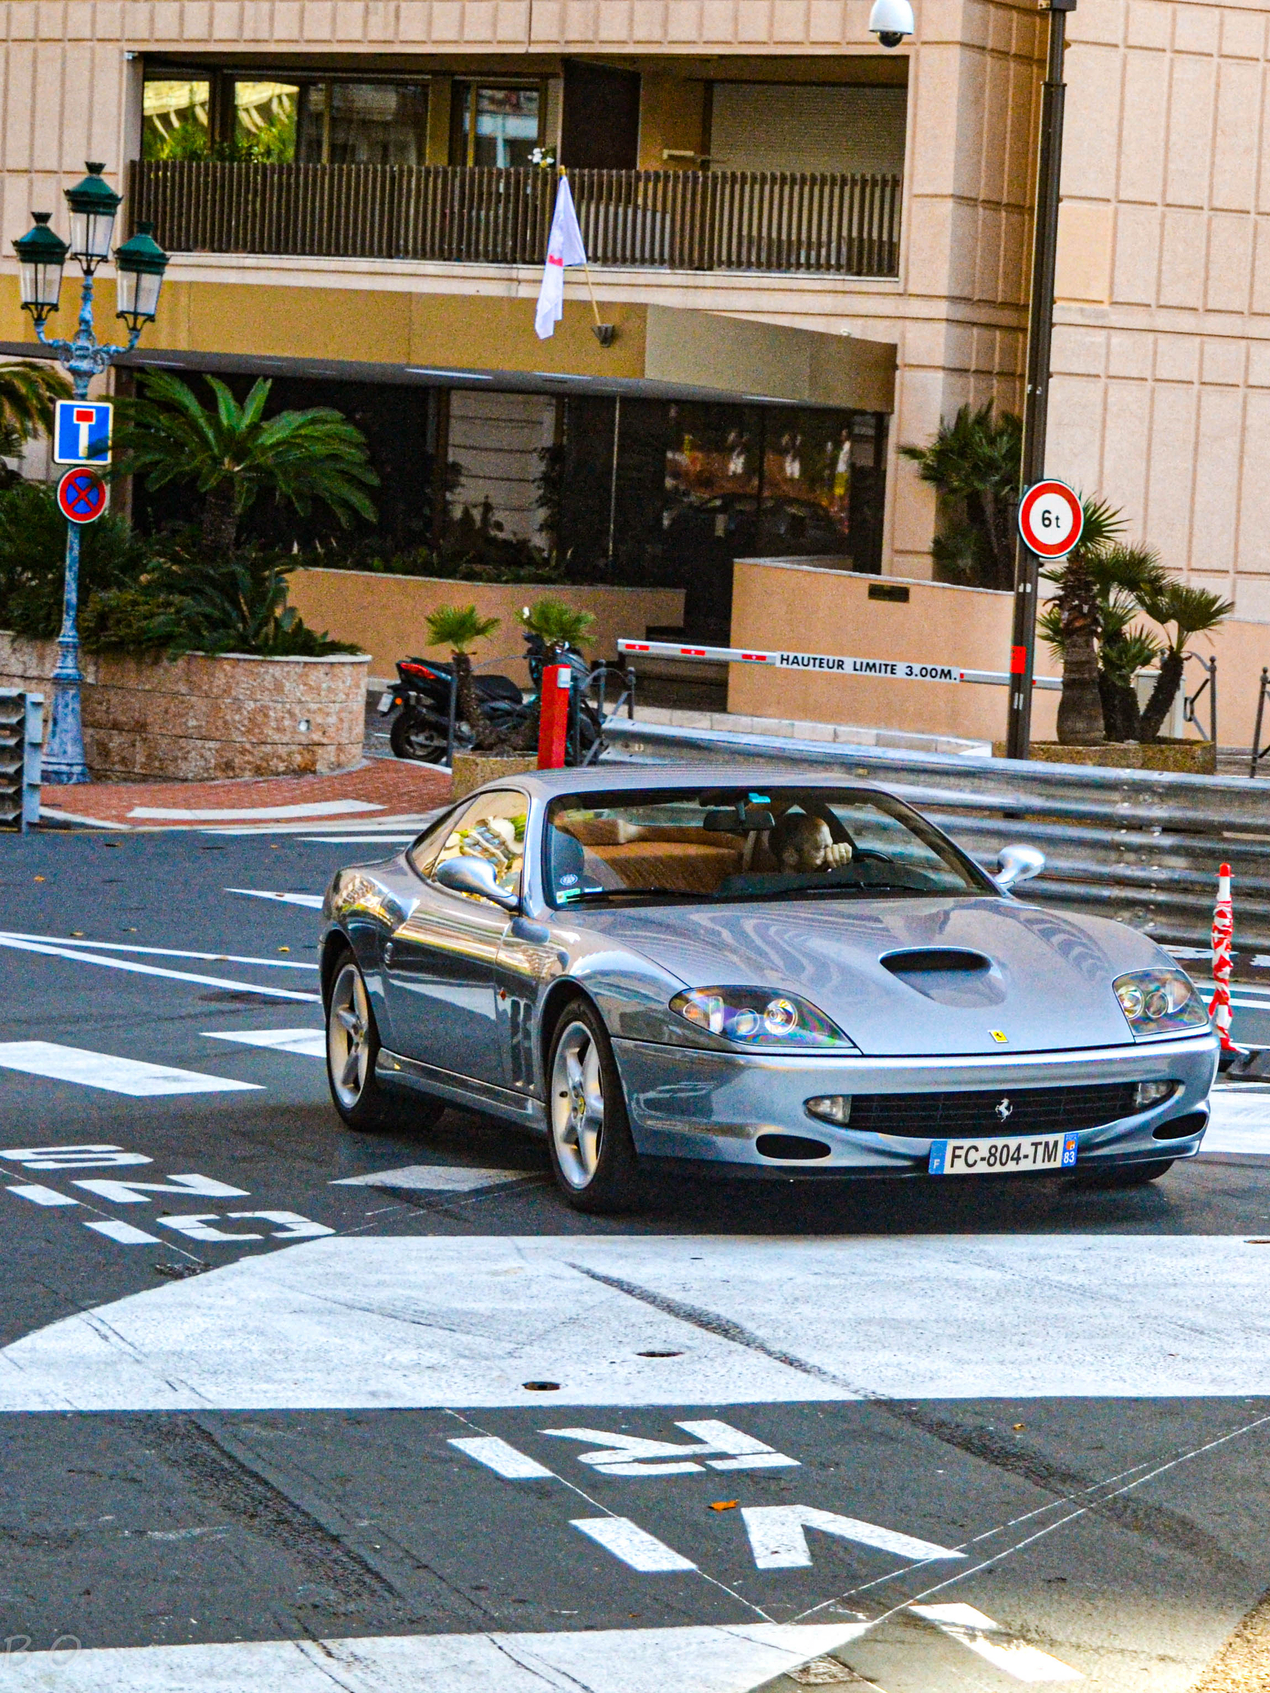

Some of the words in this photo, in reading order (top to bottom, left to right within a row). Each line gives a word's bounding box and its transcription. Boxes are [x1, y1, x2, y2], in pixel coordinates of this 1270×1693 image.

[780, 654, 845, 671] HAUTEUR
[853, 660, 898, 675] LIMITE
[905, 665, 958, 681] 3.00M.
[933, 1159, 941, 1170] F
[949, 1139, 1060, 1169] FC-804-TM
[1063, 1151, 1076, 1164] 83
